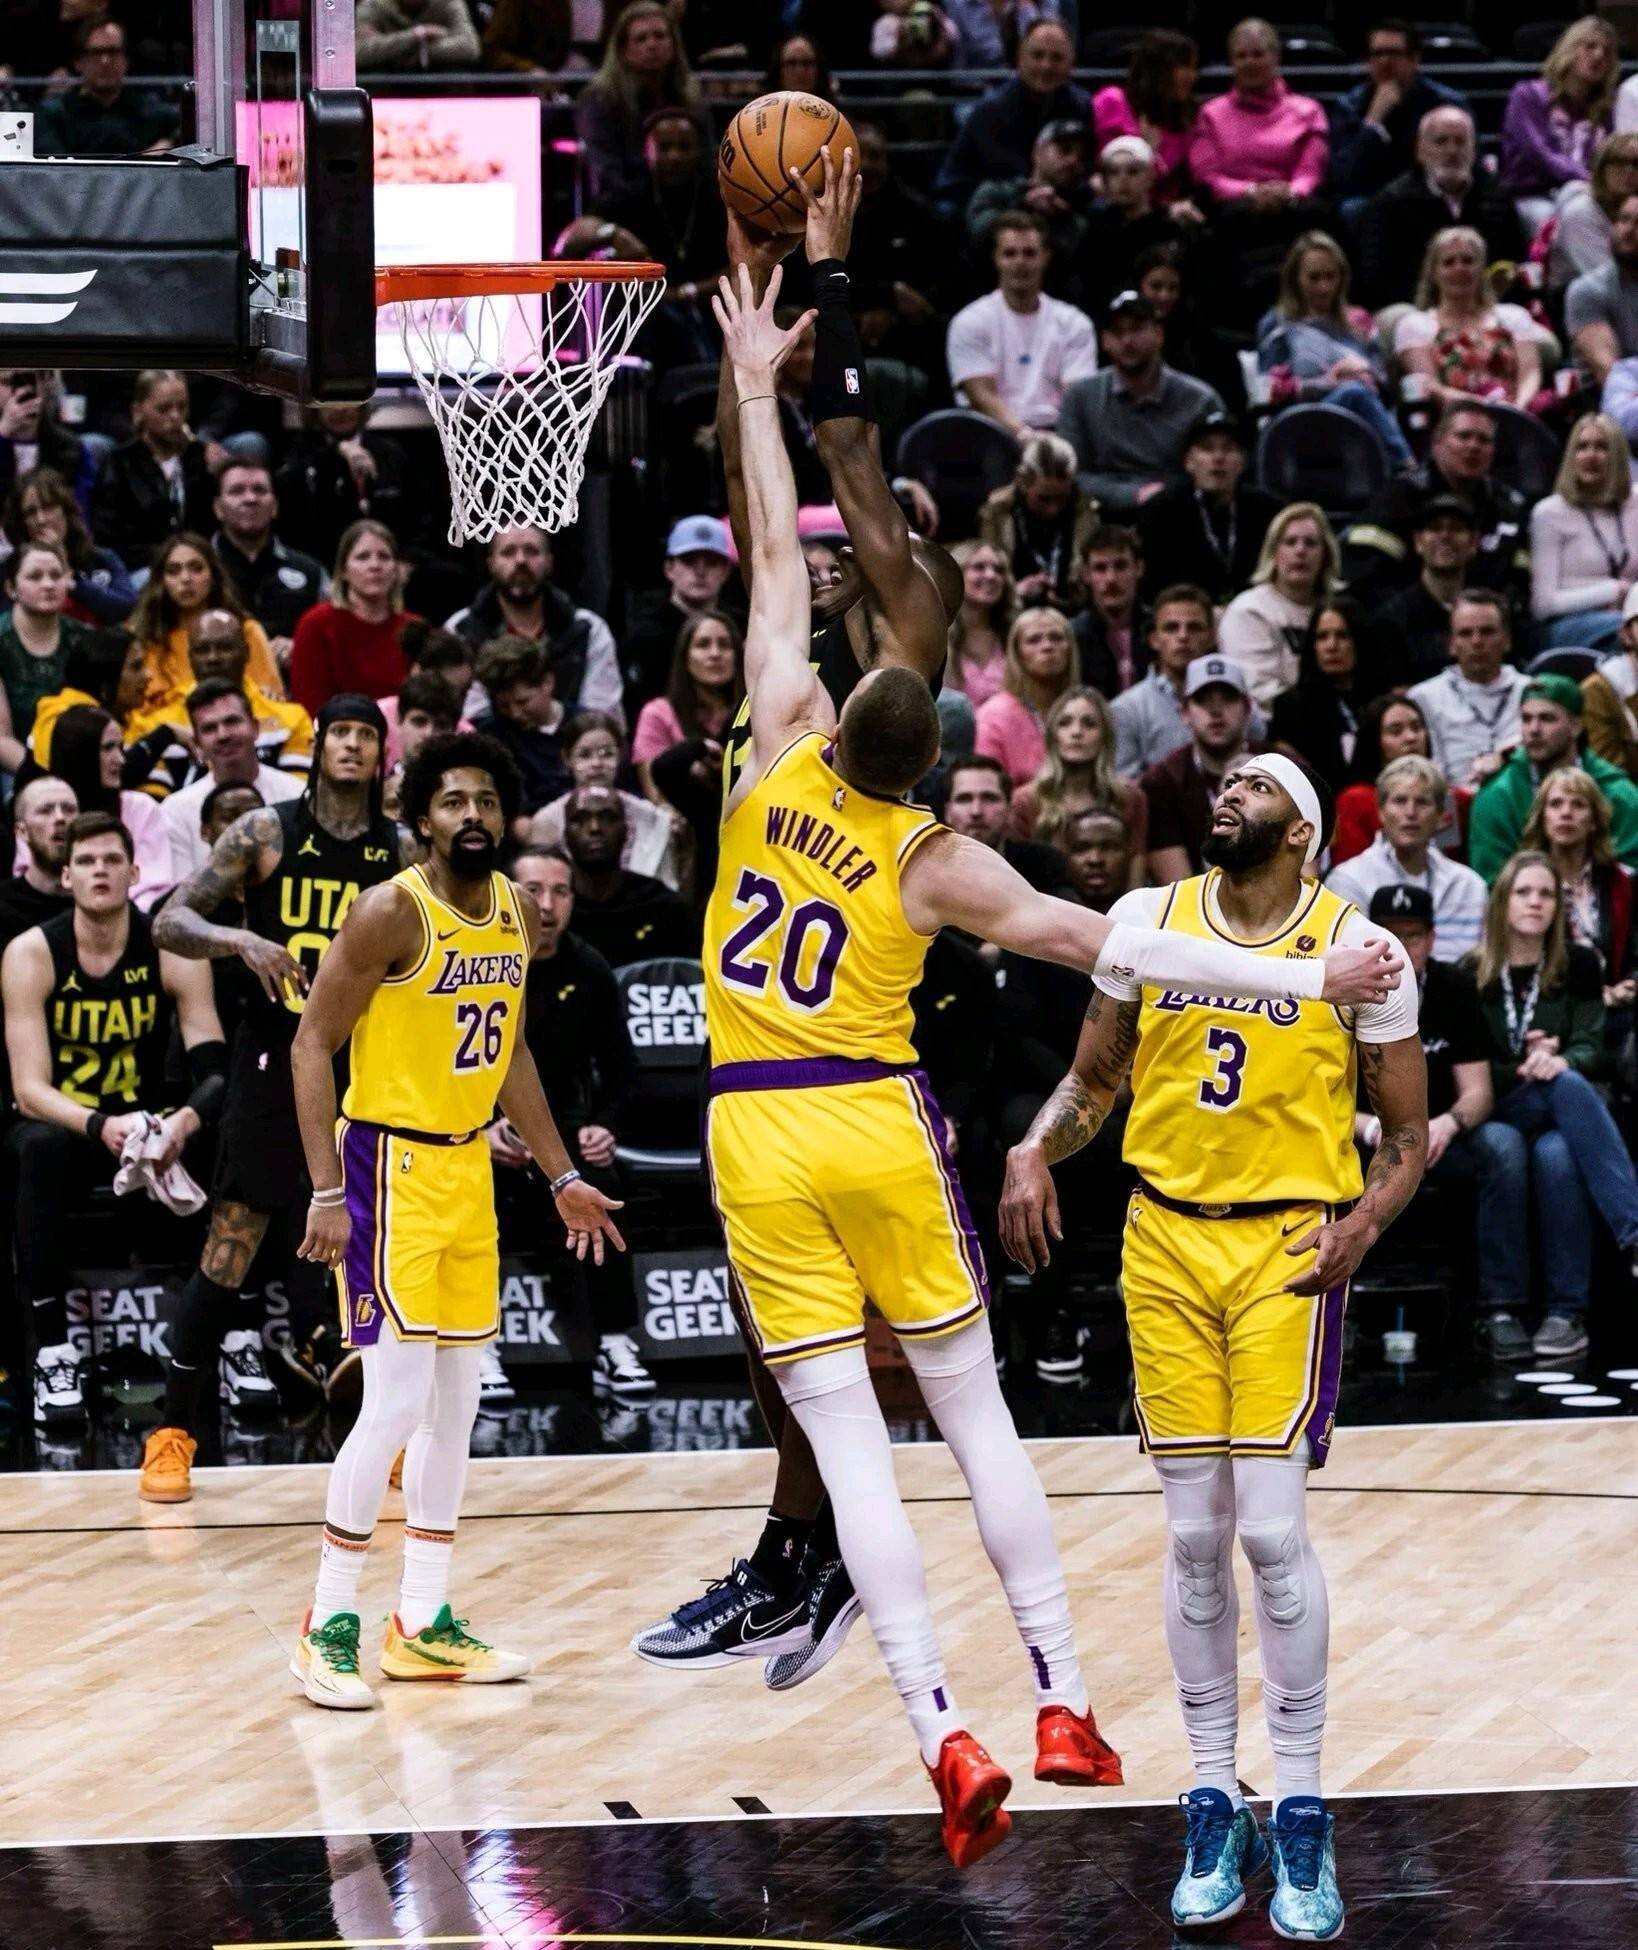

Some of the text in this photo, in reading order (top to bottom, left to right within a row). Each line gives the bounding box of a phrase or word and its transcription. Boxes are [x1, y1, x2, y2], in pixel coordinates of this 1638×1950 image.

[766, 806, 877, 894] WINDLER
[281, 876, 360, 931] UTA
[720, 866, 850, 1014] 20
[124, 966, 149, 984] LVT
[427, 950, 523, 994] LAKERS
[54, 994, 157, 1043] UTAH
[627, 983, 706, 1015] SEAT
[455, 1001, 508, 1069] 26
[58, 1043, 142, 1109] 24
[1199, 1027, 1248, 1108] 3
[65, 1285, 164, 1322] SEAT
[500, 1276, 550, 1309] AT
